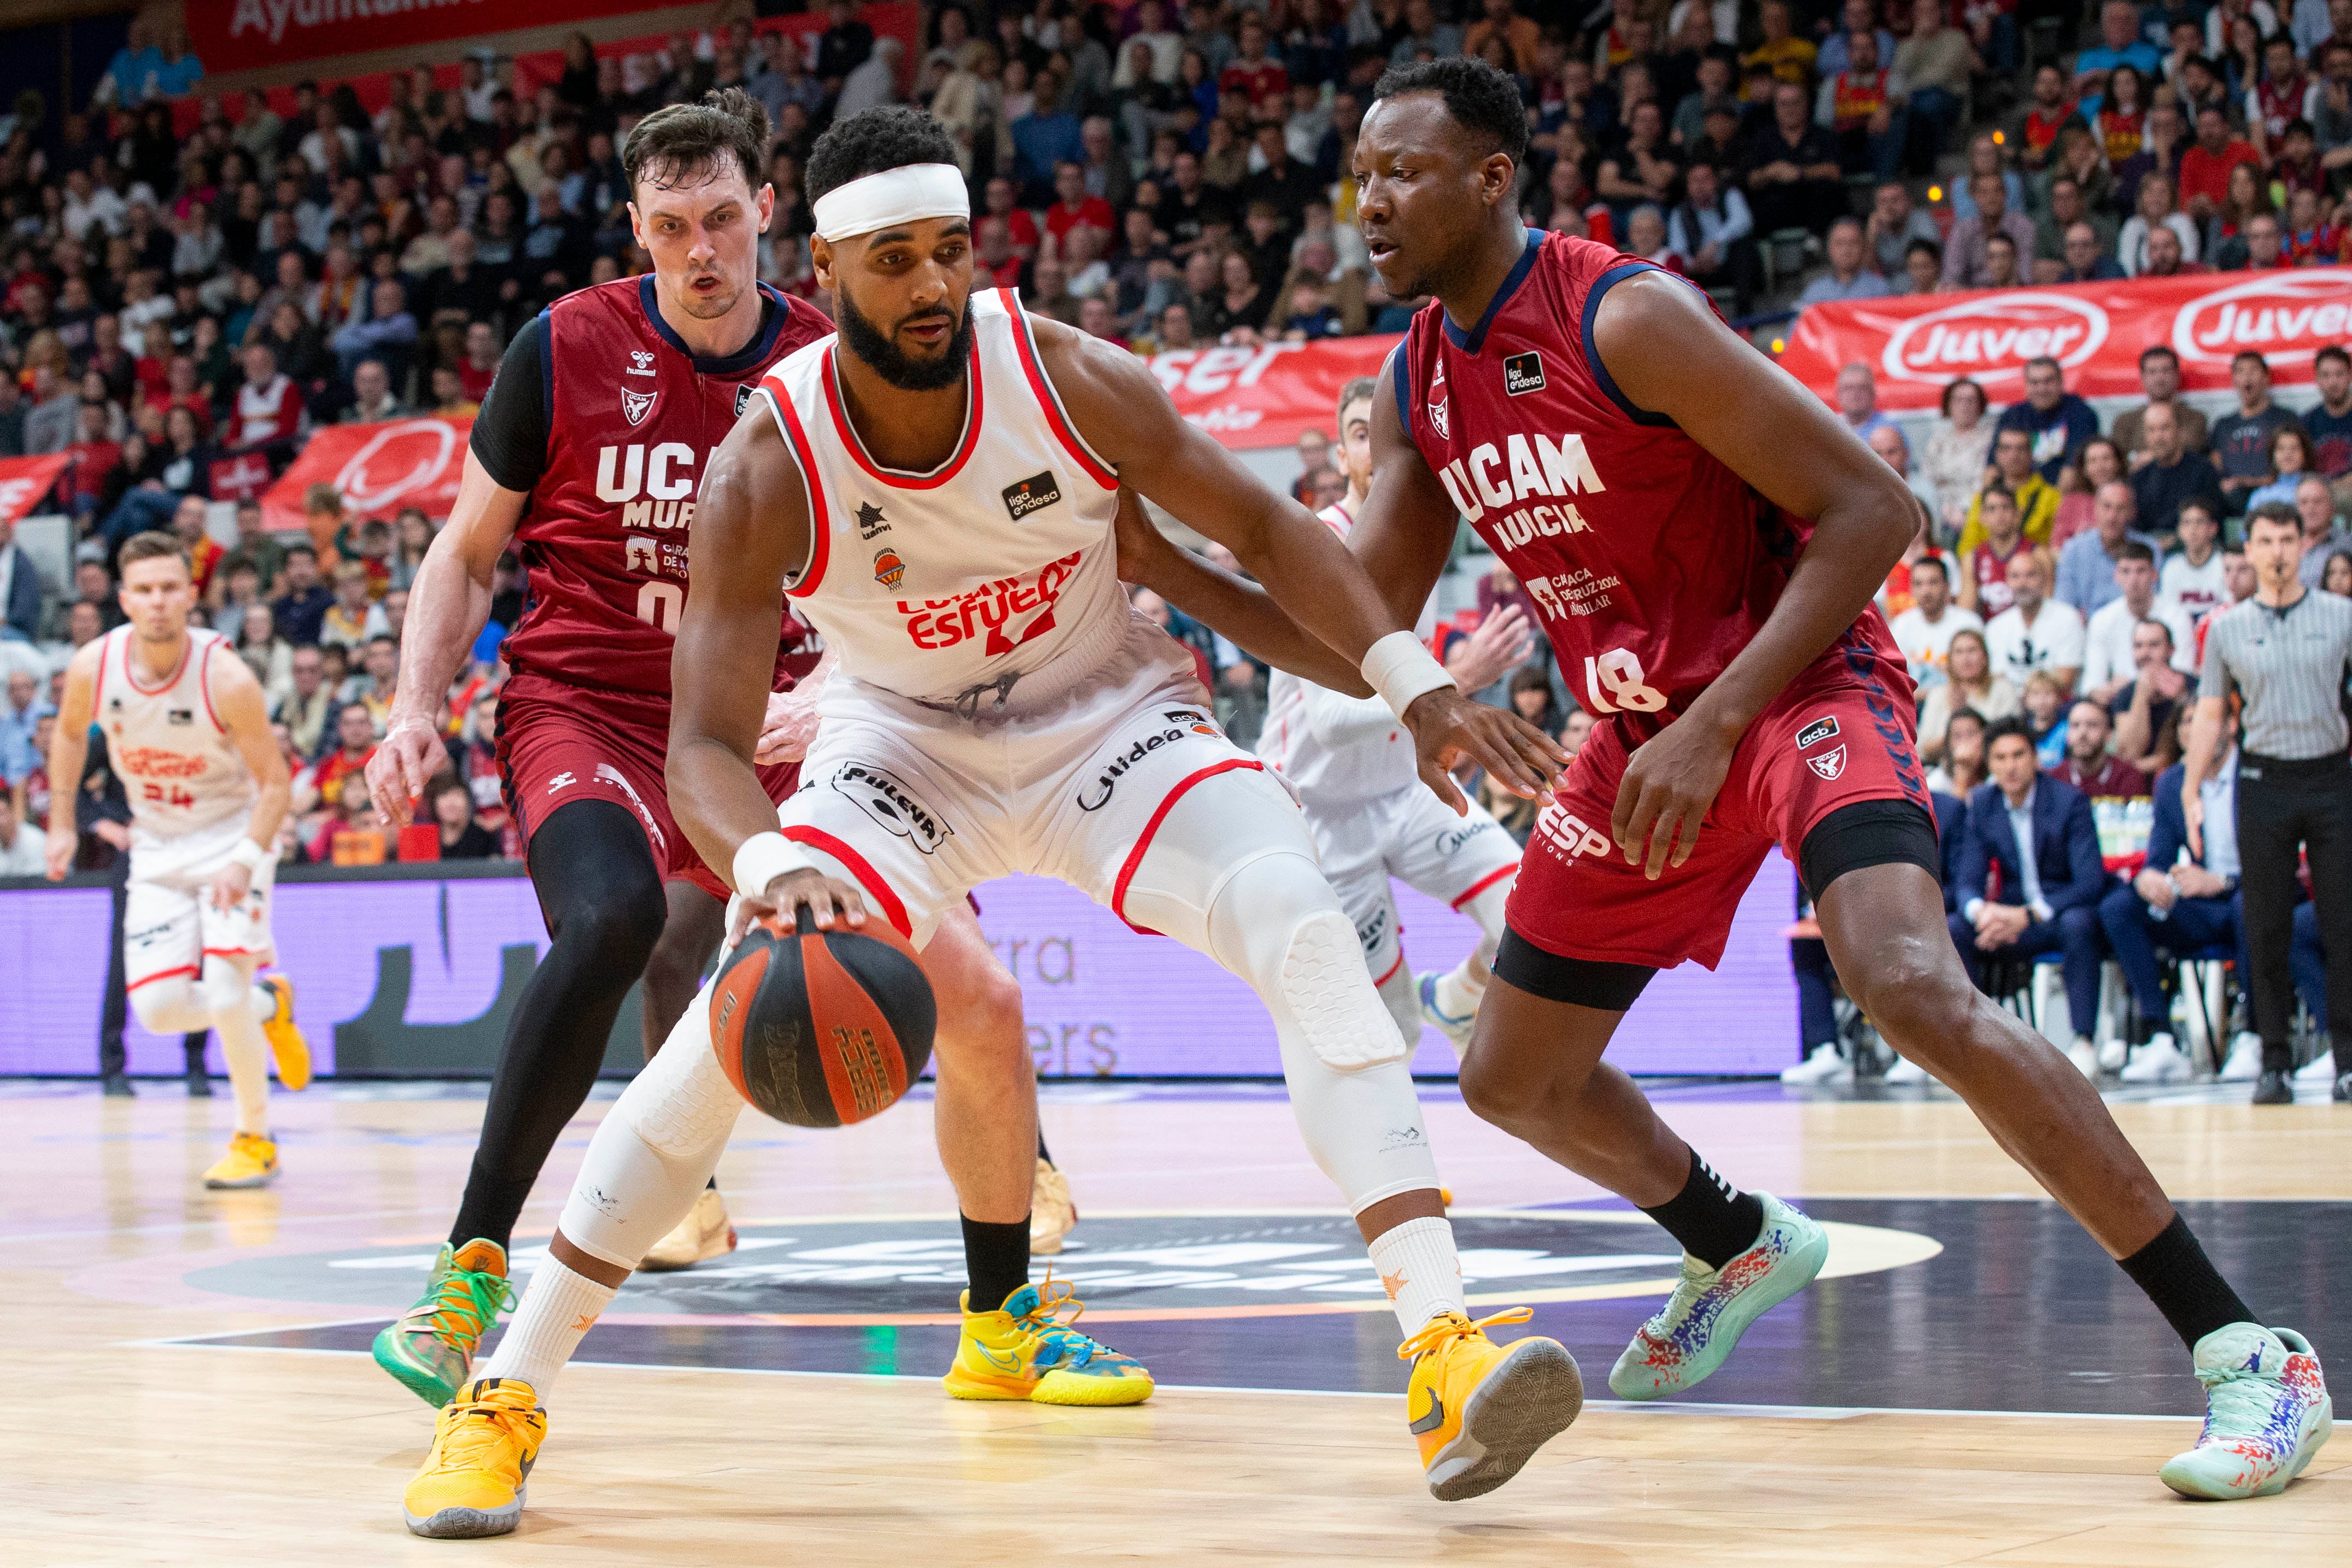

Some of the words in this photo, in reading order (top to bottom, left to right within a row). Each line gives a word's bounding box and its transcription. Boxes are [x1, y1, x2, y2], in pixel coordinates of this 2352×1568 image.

[2200, 301, 2352, 347] Juve
[1906, 324, 2081, 366] Juver
[627, 366, 656, 377] hummel
[1137, 341, 1307, 394] ser
[1508, 369, 1522, 380] liga
[1510, 375, 1542, 390] endesa
[629, 394, 647, 402] UCAM
[739, 395, 748, 407] lig
[596, 442, 718, 503] UC
[1438, 433, 1607, 524] UCAM
[1008, 491, 1030, 507] liga
[1014, 490, 1058, 516] endesa
[622, 500, 697, 530] MUR
[663, 555, 677, 567] DE
[1573, 581, 1598, 601] RUZ
[1596, 576, 1621, 590] 2024
[1584, 647, 1668, 713] 18
[1172, 713, 1198, 722] acb
[1801, 728, 1829, 745] acb
[1816, 752, 1838, 764] UCAM
[843, 767, 936, 840] PULEVA
[1537, 800, 1611, 858] ESP
[1532, 826, 1574, 867] UTIONS
[1024, 1023, 1119, 1075] ers
